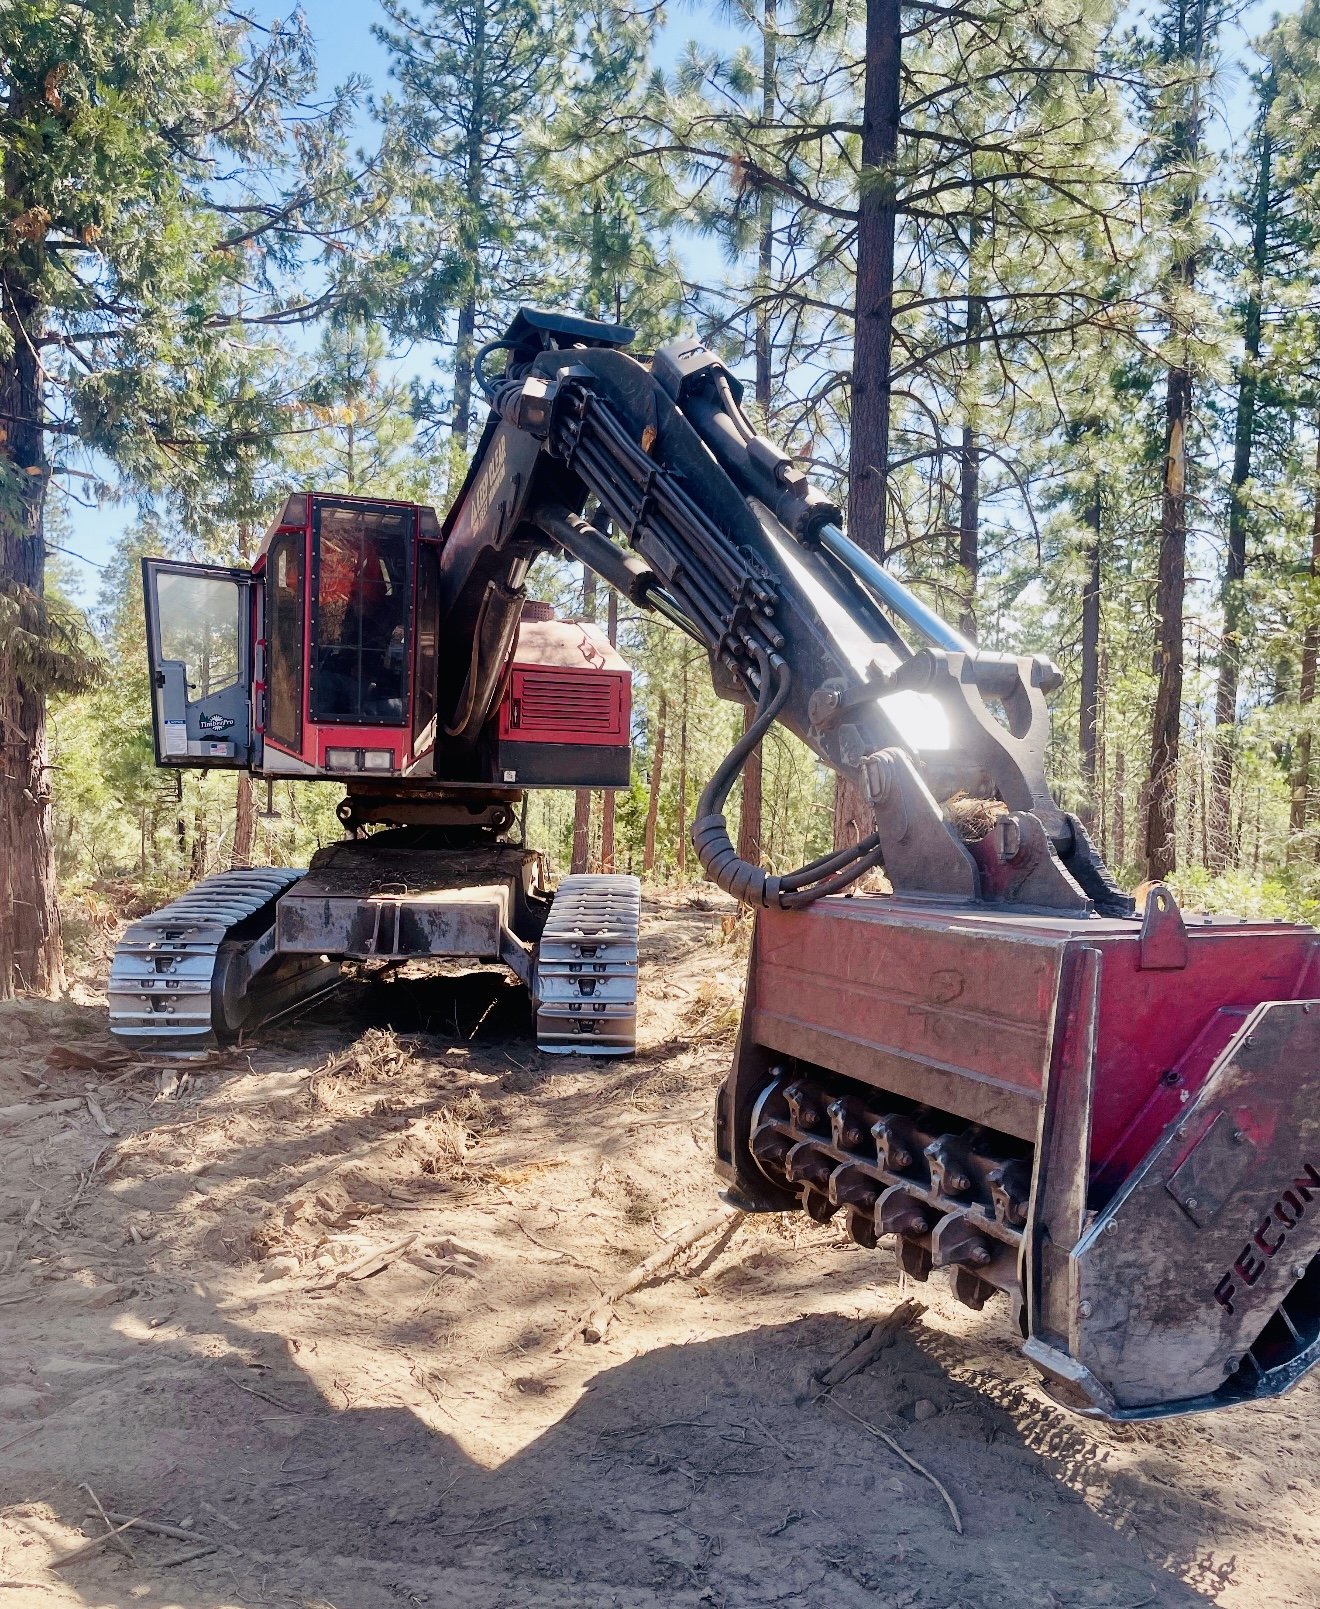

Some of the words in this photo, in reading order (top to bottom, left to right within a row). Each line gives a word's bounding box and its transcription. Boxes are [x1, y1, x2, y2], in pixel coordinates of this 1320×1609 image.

[488, 434, 507, 486] CLEAR
[200, 719, 233, 728] TimberPro
[1214, 1163, 1320, 1316] FECON
